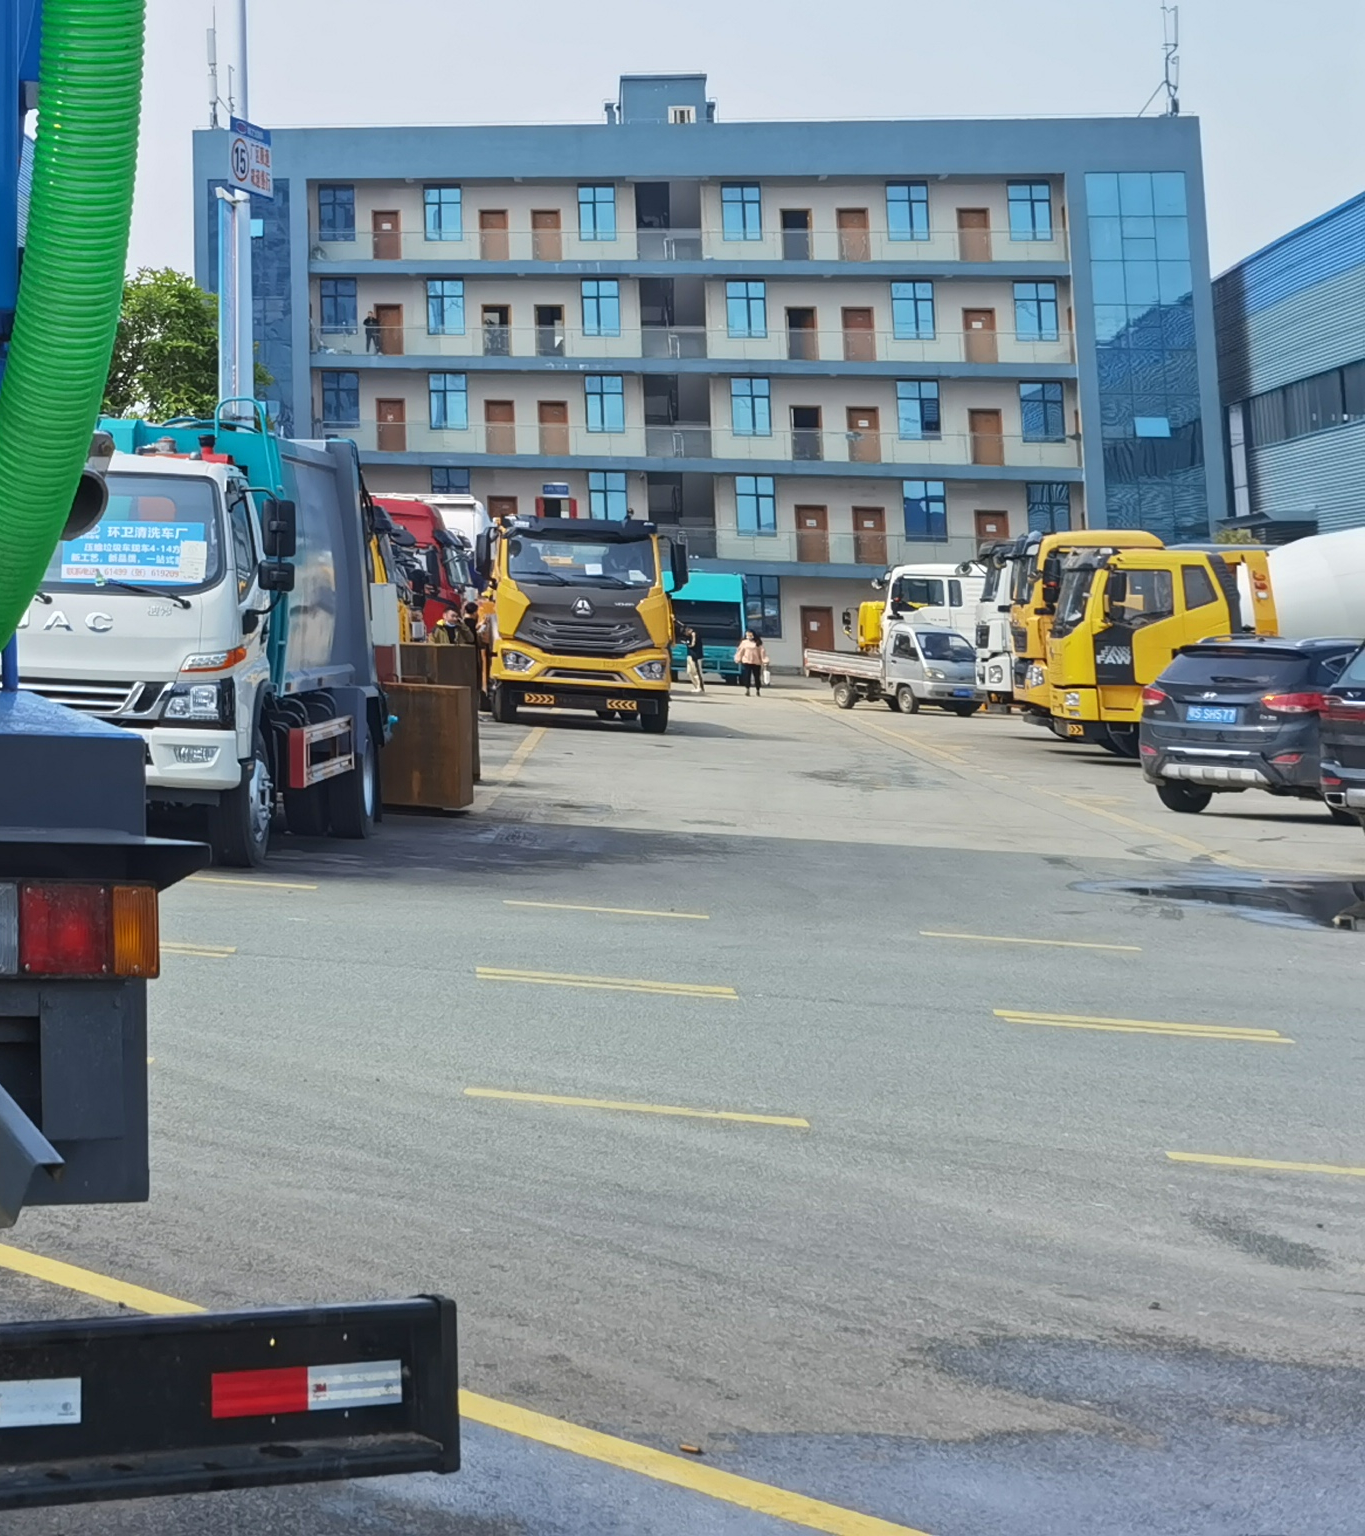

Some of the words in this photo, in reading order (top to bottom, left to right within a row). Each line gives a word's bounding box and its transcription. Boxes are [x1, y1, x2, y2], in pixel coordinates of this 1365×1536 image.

[235, 147, 246, 174] 15
[107, 525, 188, 540] 环卫清洗车厂
[1096, 650, 1131, 665] FAW
